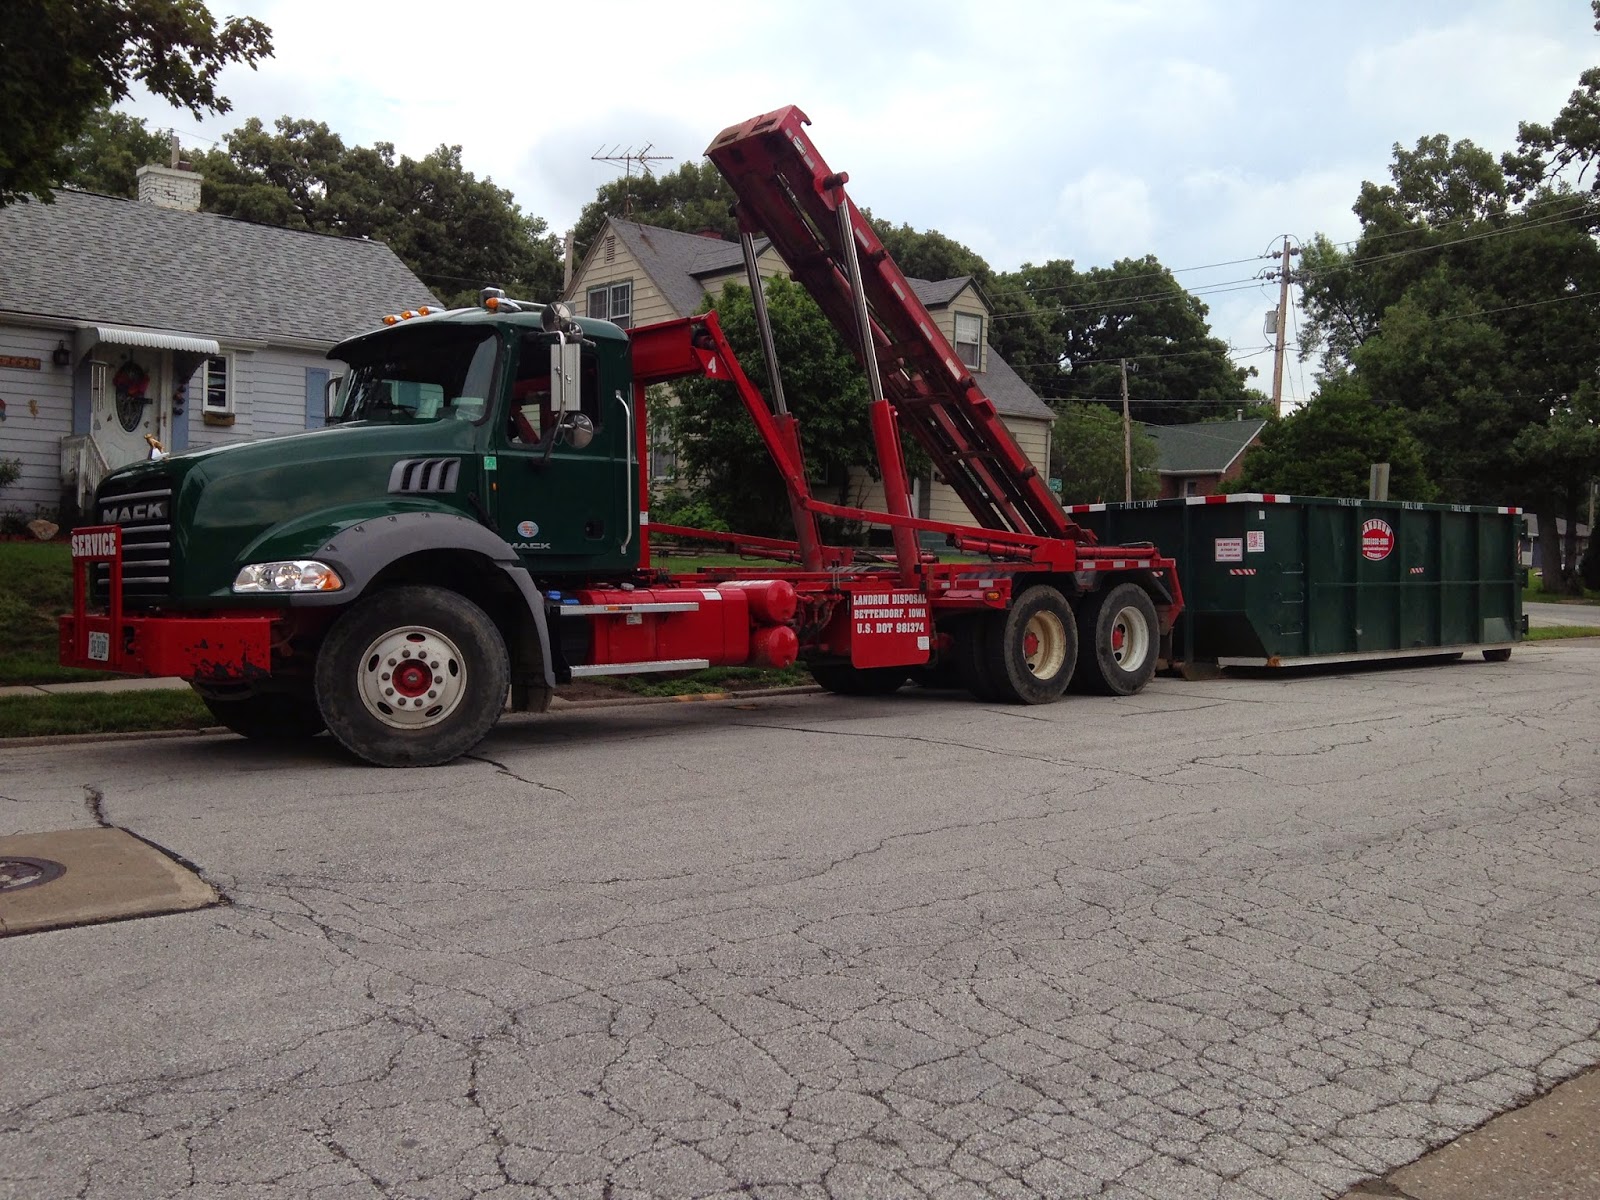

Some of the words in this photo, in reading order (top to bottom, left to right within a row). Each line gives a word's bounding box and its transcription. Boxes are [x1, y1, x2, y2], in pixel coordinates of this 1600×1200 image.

[707, 356, 717, 374] 4
[103, 503, 163, 522] MACK
[72, 533, 116, 557] SERVICE
[853, 594, 889, 605] LANDRUM
[892, 594, 927, 604] DISPOSAL
[854, 608, 906, 620] BETTENDORF,
[908, 608, 926, 618] IOWA
[857, 623, 873, 634] U.S.
[876, 623, 894, 634] DOT
[896, 622, 925, 633] 981374
